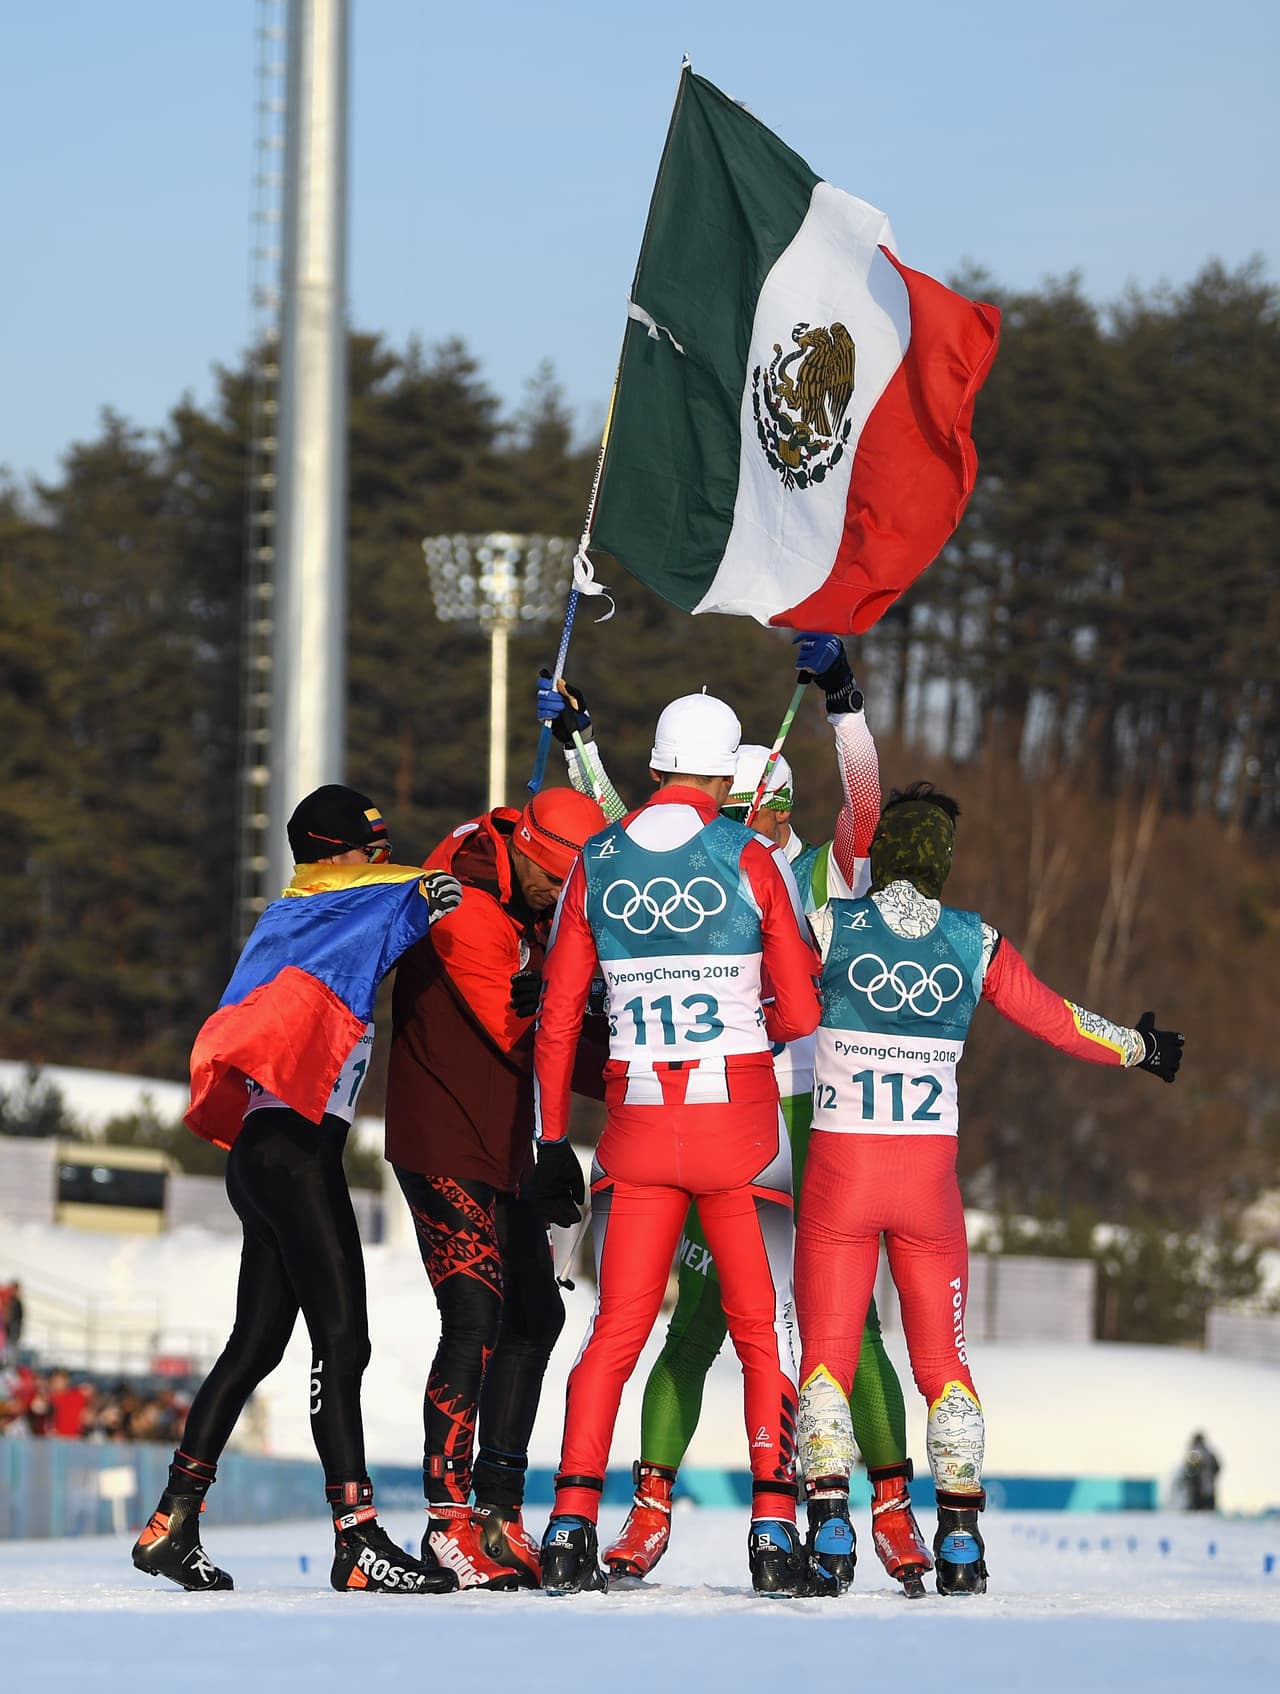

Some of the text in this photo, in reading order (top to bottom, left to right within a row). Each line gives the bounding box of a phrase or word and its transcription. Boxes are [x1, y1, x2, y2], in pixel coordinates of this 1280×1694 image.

[608, 966, 740, 983] PyeongChang 2018
[624, 993, 725, 1045] 113
[834, 1041, 956, 1063] PyeongChang 2018
[852, 1070, 943, 1122] 112
[429, 1531, 490, 1590] alpina
